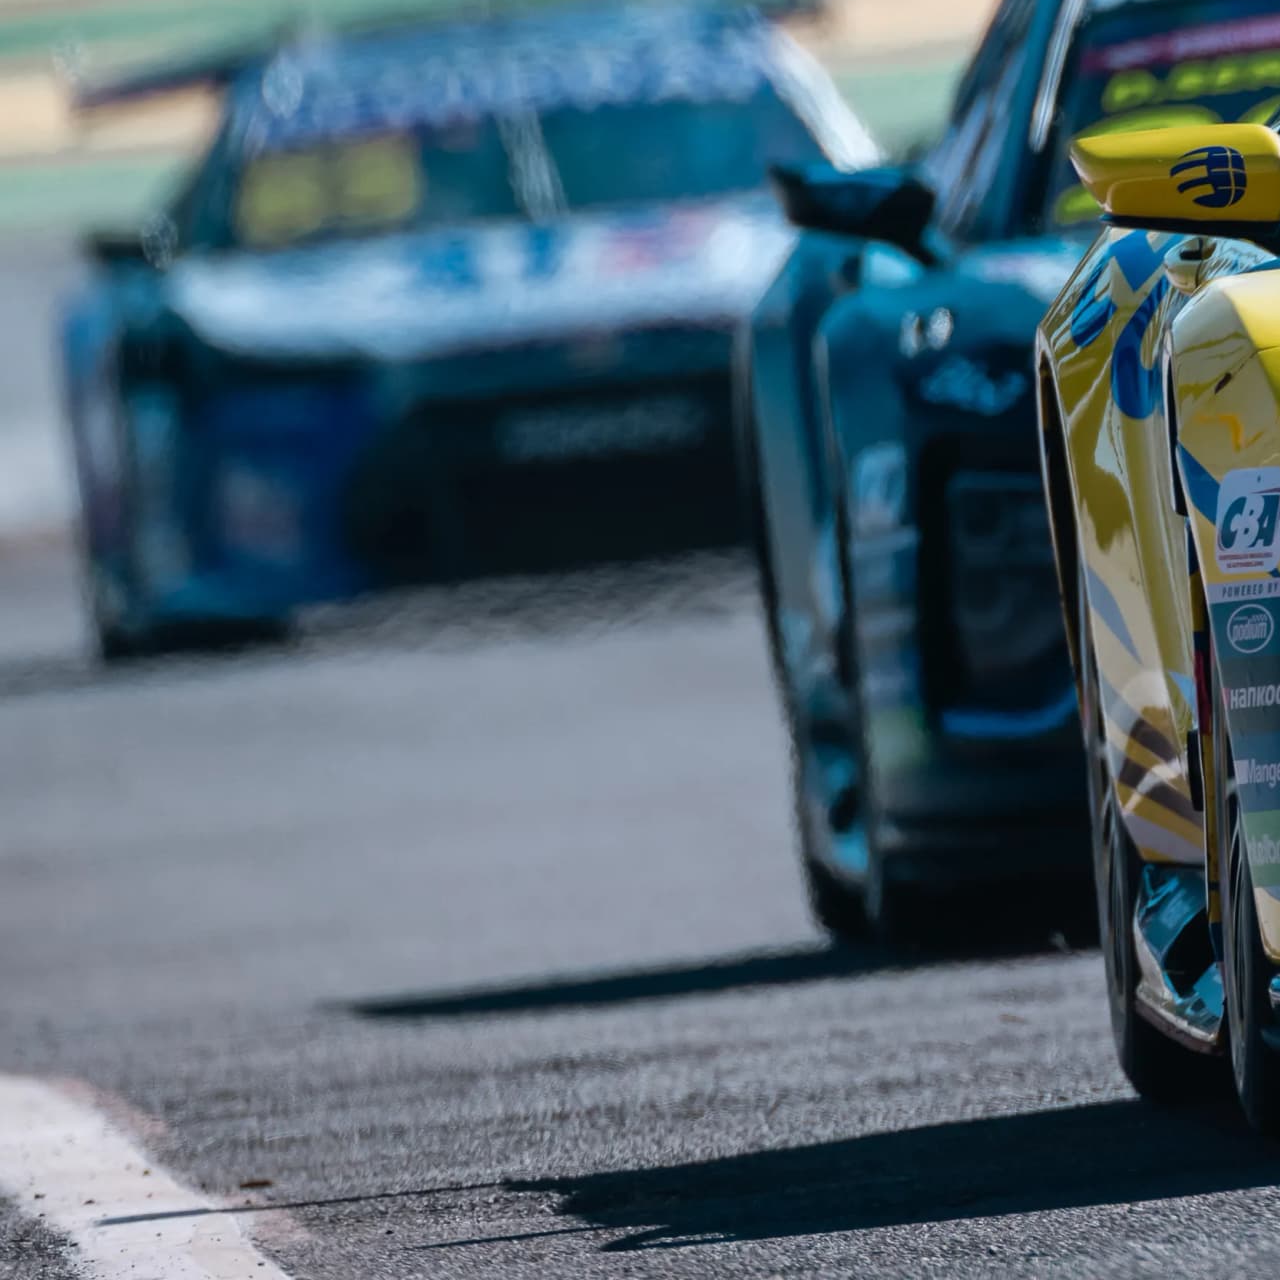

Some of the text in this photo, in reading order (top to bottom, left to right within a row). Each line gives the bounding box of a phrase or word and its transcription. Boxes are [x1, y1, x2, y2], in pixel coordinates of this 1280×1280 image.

[1220, 492, 1280, 550] CBA
[1221, 581, 1280, 598] POWERED BY
